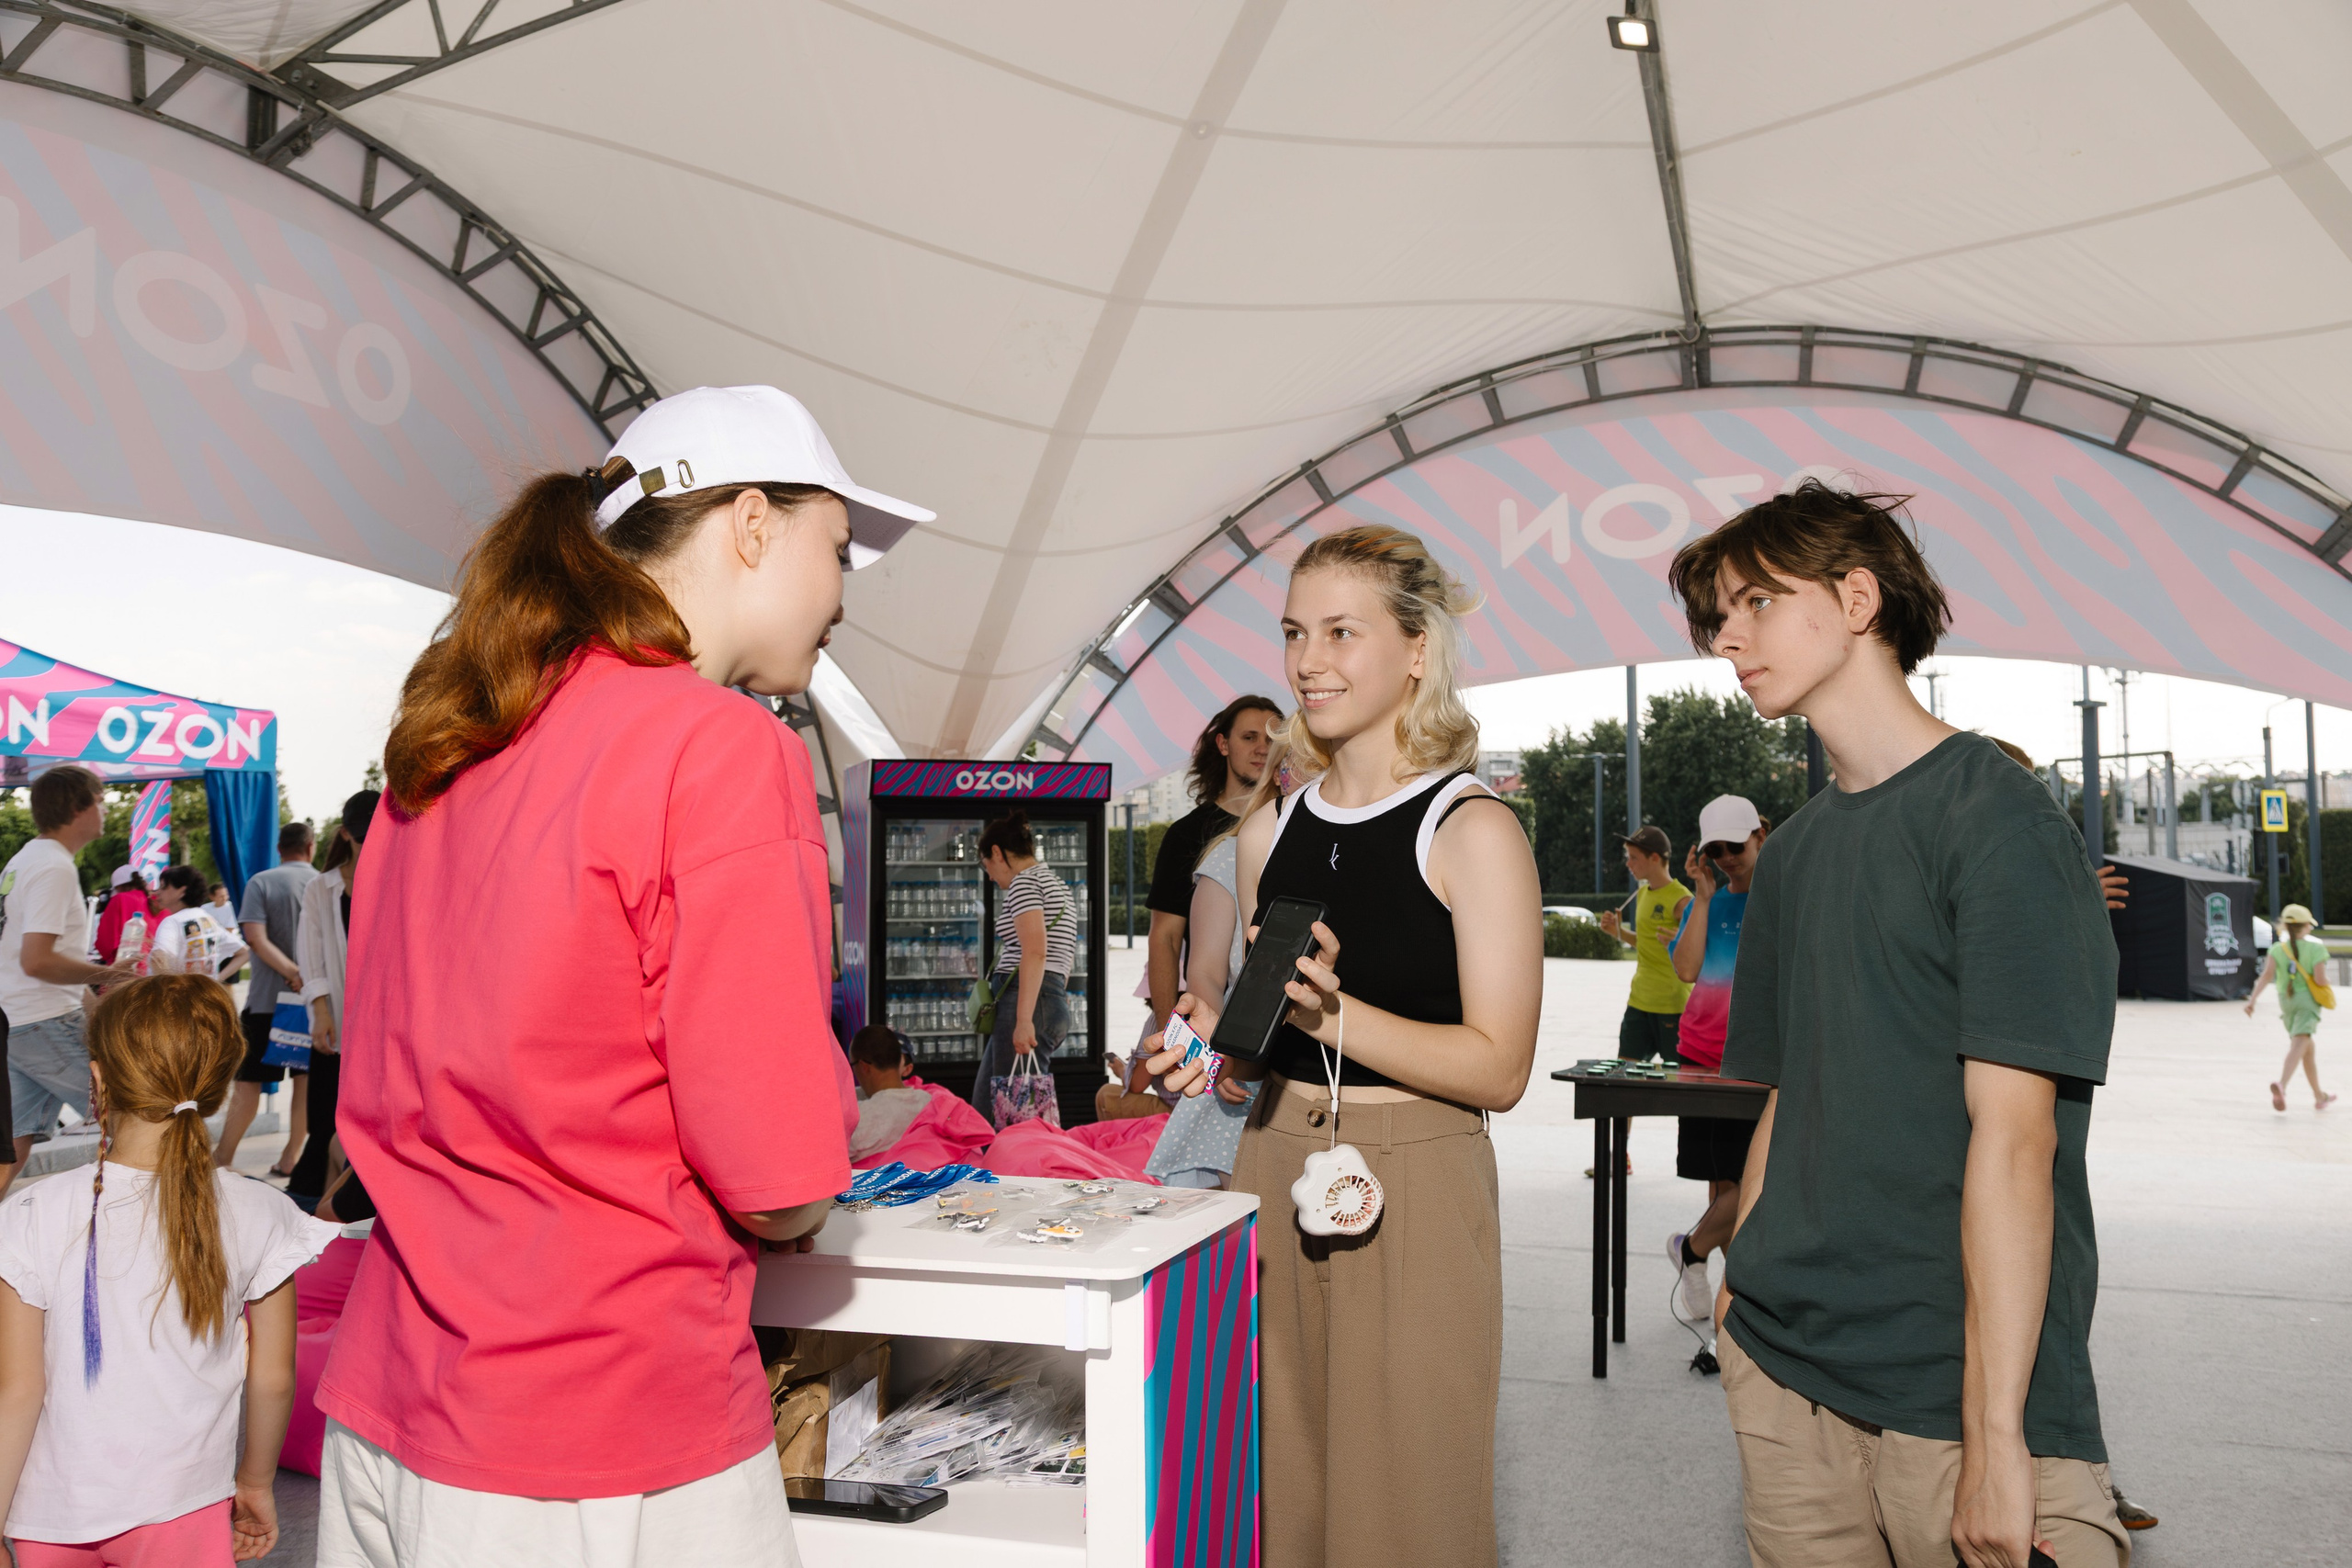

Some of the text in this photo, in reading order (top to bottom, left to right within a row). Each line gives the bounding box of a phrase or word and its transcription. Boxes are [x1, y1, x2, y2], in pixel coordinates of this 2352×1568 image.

[97, 705, 261, 761] OZON
[956, 770, 1034, 791] OZON
[843, 941, 865, 965] OZON
